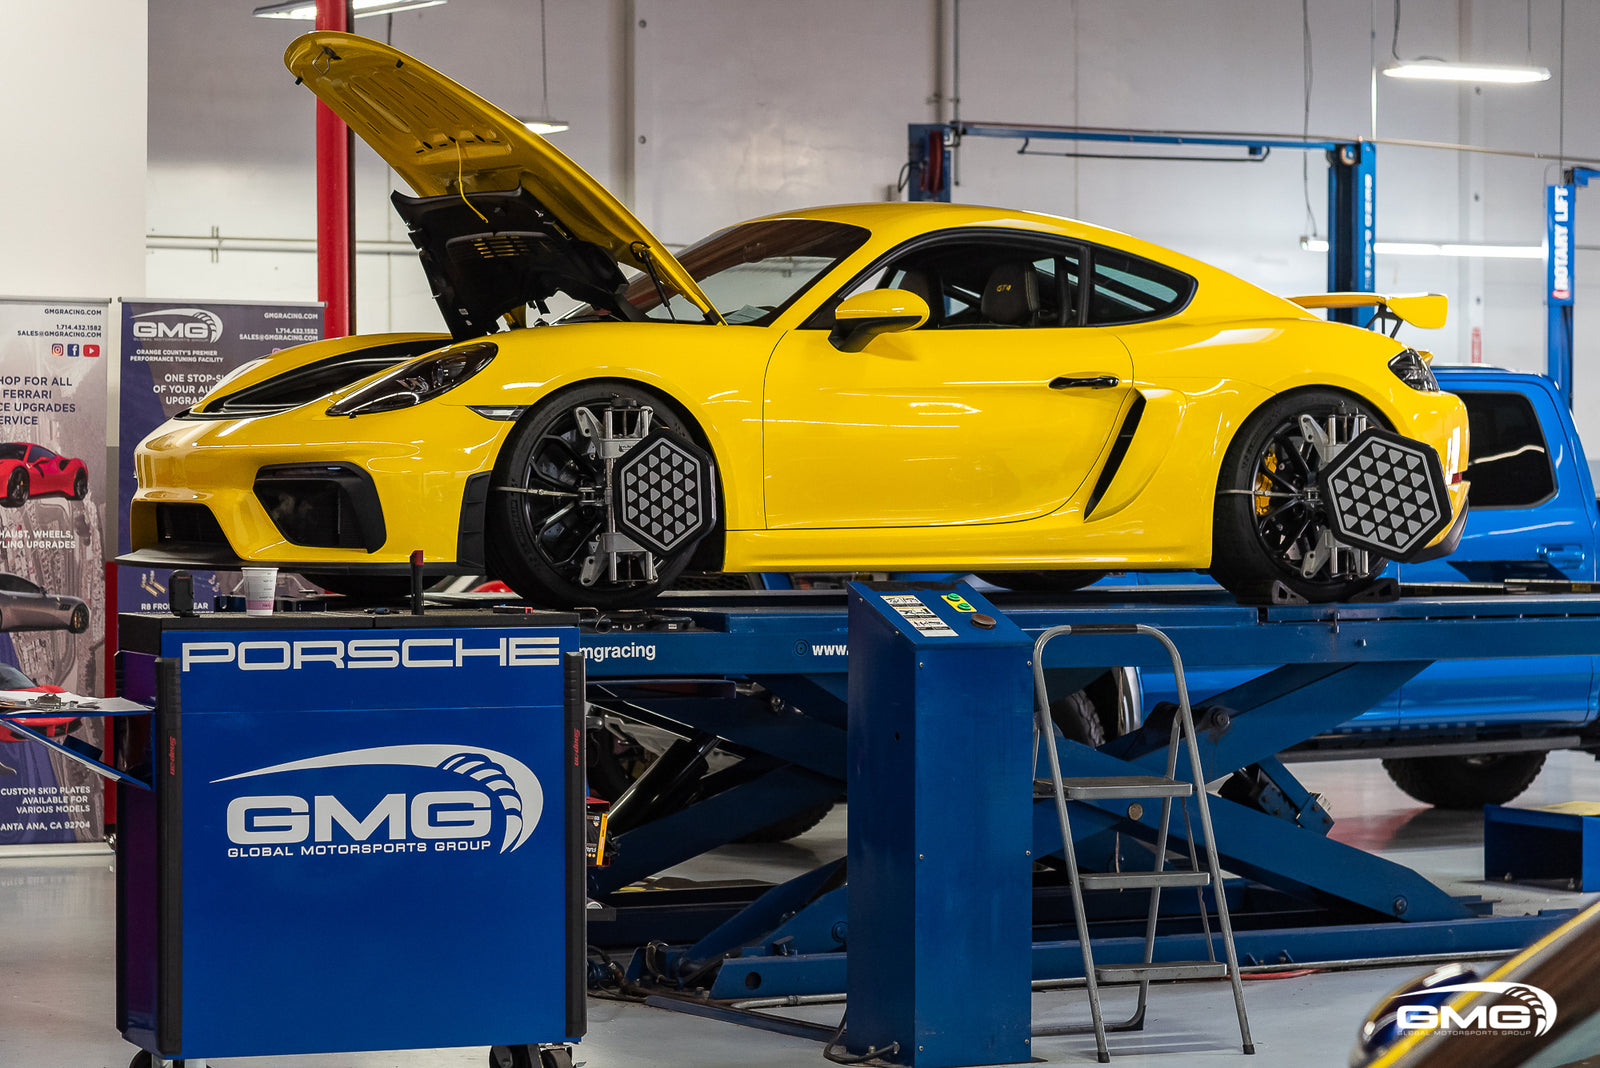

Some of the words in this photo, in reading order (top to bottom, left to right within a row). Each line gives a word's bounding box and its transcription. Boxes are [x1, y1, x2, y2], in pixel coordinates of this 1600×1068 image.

[1554, 186, 1569, 222] LIFT
[1554, 224, 1569, 290] ROTARY
[264, 312, 318, 320] GMGRACING.COM
[17, 330, 102, 338] SALES@GMGRACING.COM
[133, 321, 209, 338] GMG
[24, 376, 48, 386] FOR
[51, 377, 73, 387] ALL
[164, 373, 185, 382] ONE
[3, 389, 52, 399] FERRARI
[153, 384, 167, 394] OF
[169, 385, 196, 394] YOUR
[14, 402, 76, 413] UPGRADES
[33, 530, 74, 540] WHEELS,
[0, 540, 24, 549] LING
[26, 540, 76, 549] UPGRADES
[141, 603, 151, 611] R8
[152, 602, 170, 611] FRO
[181, 636, 560, 673] PORSCHE
[0, 787, 36, 796] CUSTOM
[37, 786, 58, 795] SKID
[60, 785, 91, 794] PLATES
[22, 796, 69, 805] AVAILABLE
[70, 795, 88, 803] FOR
[16, 806, 54, 814] VARIOUS
[55, 805, 91, 813] MODELS
[226, 790, 492, 845] GMG
[26, 822, 48, 831] ANA,
[49, 821, 63, 830] CA
[64, 821, 91, 830] 92704
[227, 846, 294, 858] GLOBAL
[300, 842, 427, 856] MOTORSPORTS
[434, 840, 492, 852] GROUP
